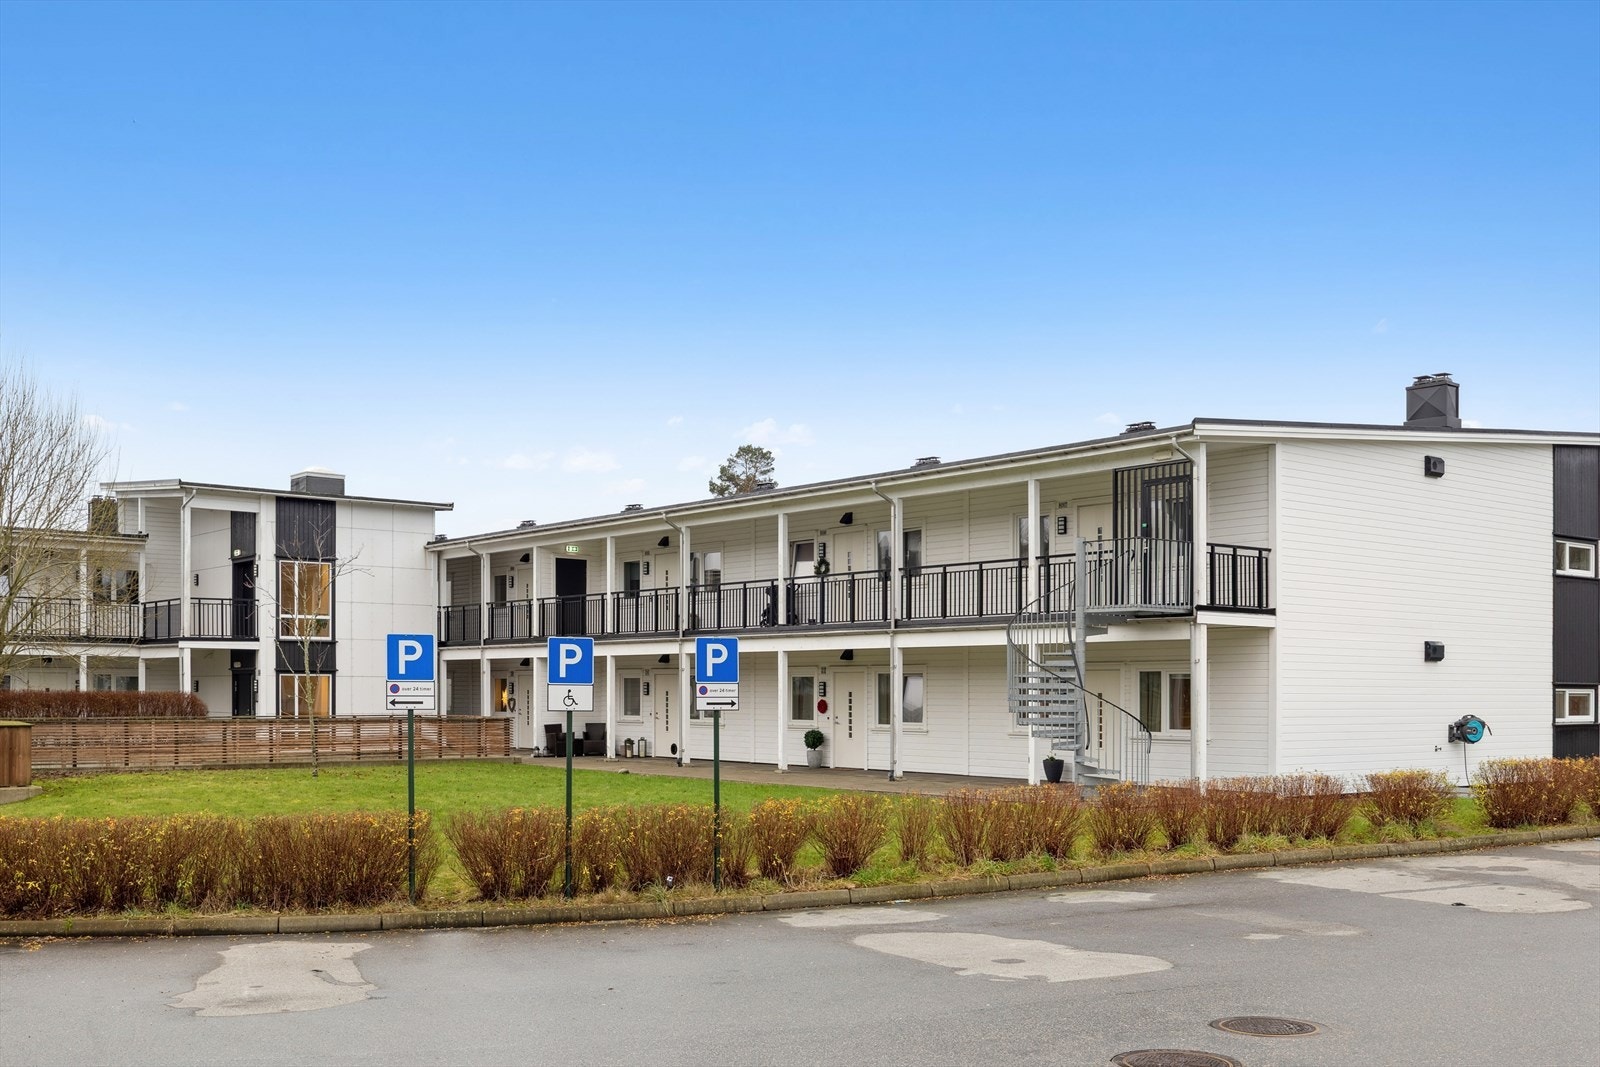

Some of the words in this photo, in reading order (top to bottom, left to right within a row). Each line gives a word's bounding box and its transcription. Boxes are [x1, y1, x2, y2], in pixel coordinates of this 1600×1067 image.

[398, 640, 423, 675] P
[559, 643, 583, 678] P
[706, 643, 729, 677] P
